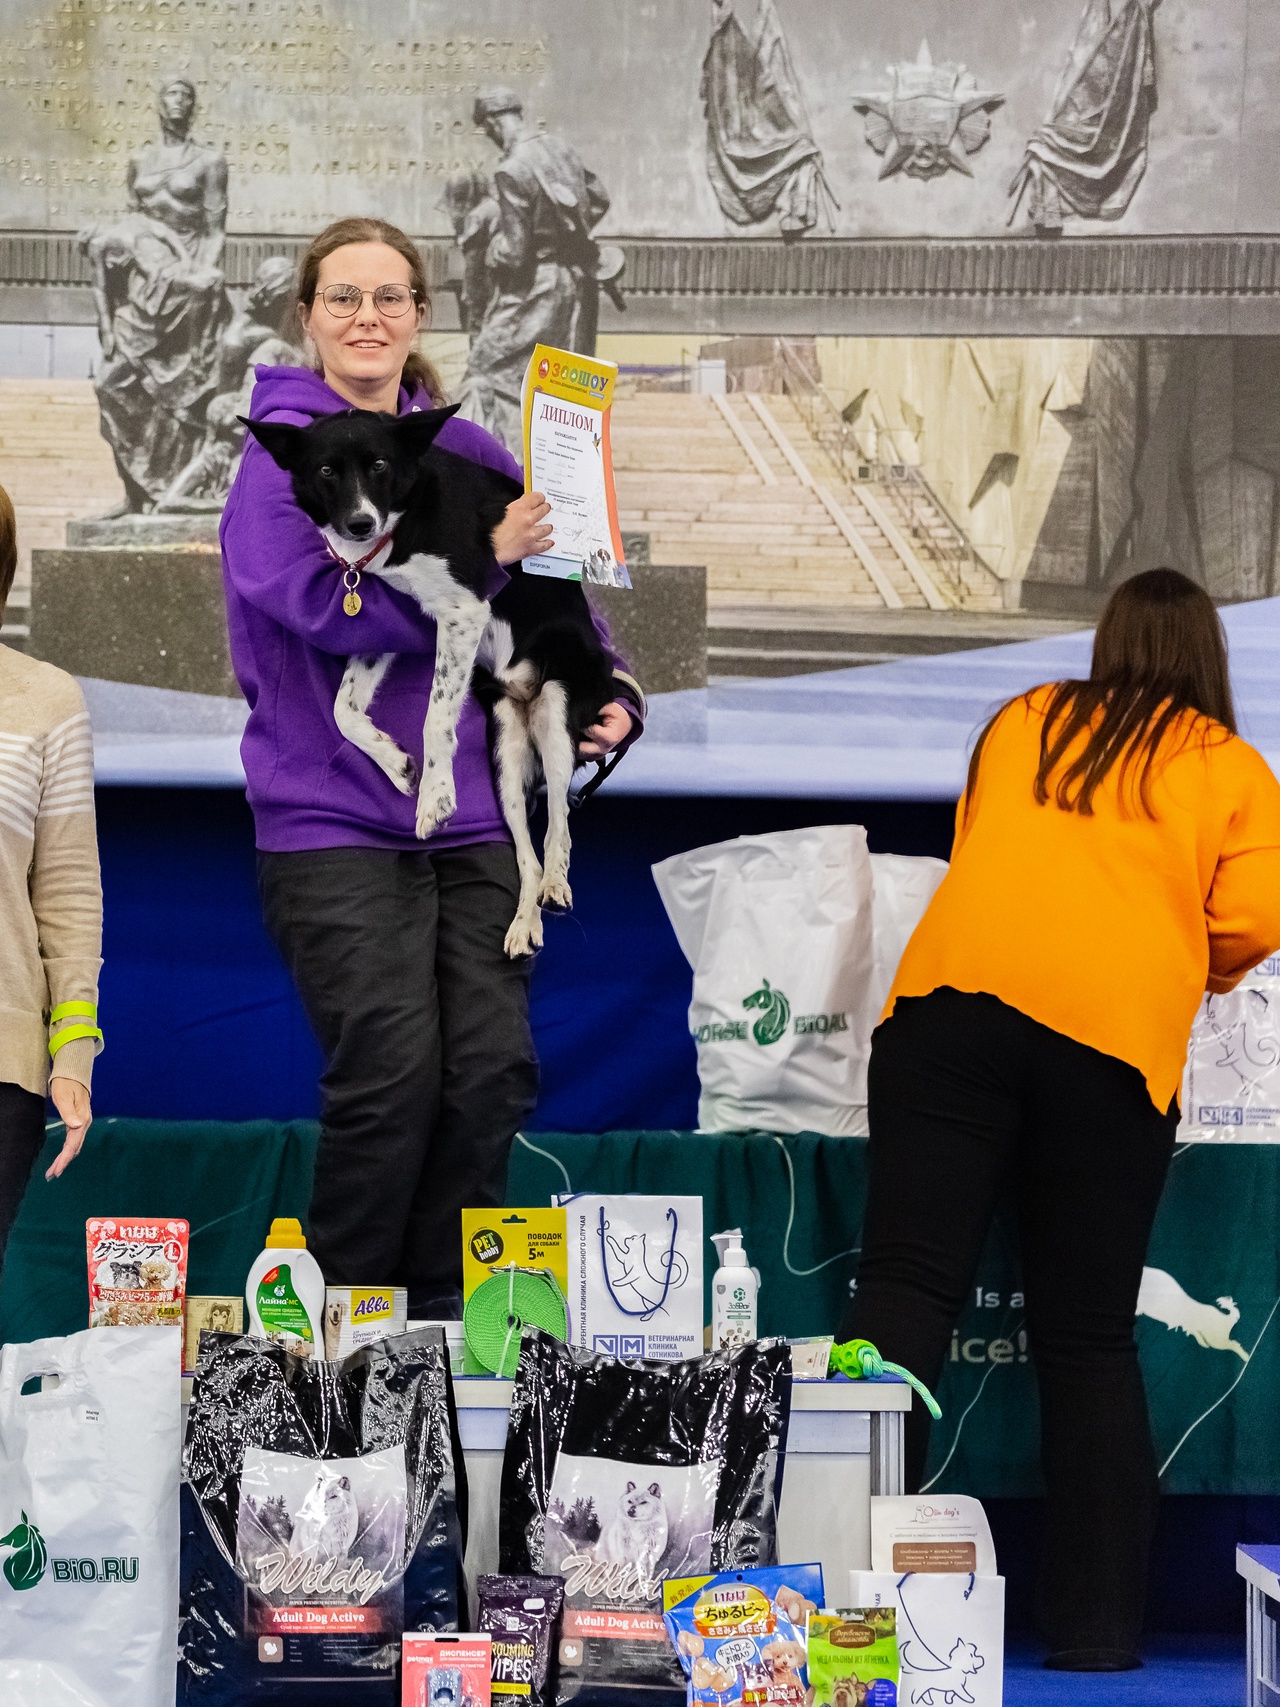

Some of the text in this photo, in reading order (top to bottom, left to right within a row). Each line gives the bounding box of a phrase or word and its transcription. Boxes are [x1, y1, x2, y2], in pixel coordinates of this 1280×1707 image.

[552, 363, 609, 391] ЗООШОУ
[540, 404, 594, 432] ДИПЛОМ
[473, 1232, 496, 1253] PET
[479, 1246, 499, 1260] hobby
[354, 1296, 390, 1316] Авва
[648, 1334, 695, 1342] ВЕТЕРИНАРНАЯ
[648, 1350, 684, 1358] СОТНИКОВА
[255, 1552, 385, 1605] Wildy
[560, 1554, 670, 1601] Wild
[272, 1611, 365, 1625] Adult Dog Active
[575, 1615, 666, 1630] Adult Dog Active
[439, 1649, 486, 1657] ДИСПЕНСЕР
[491, 1642, 534, 1657] ROOMING
[817, 1655, 890, 1664] МЕДАЛЬОНЫ ИЗ ЯГНЕНКА
